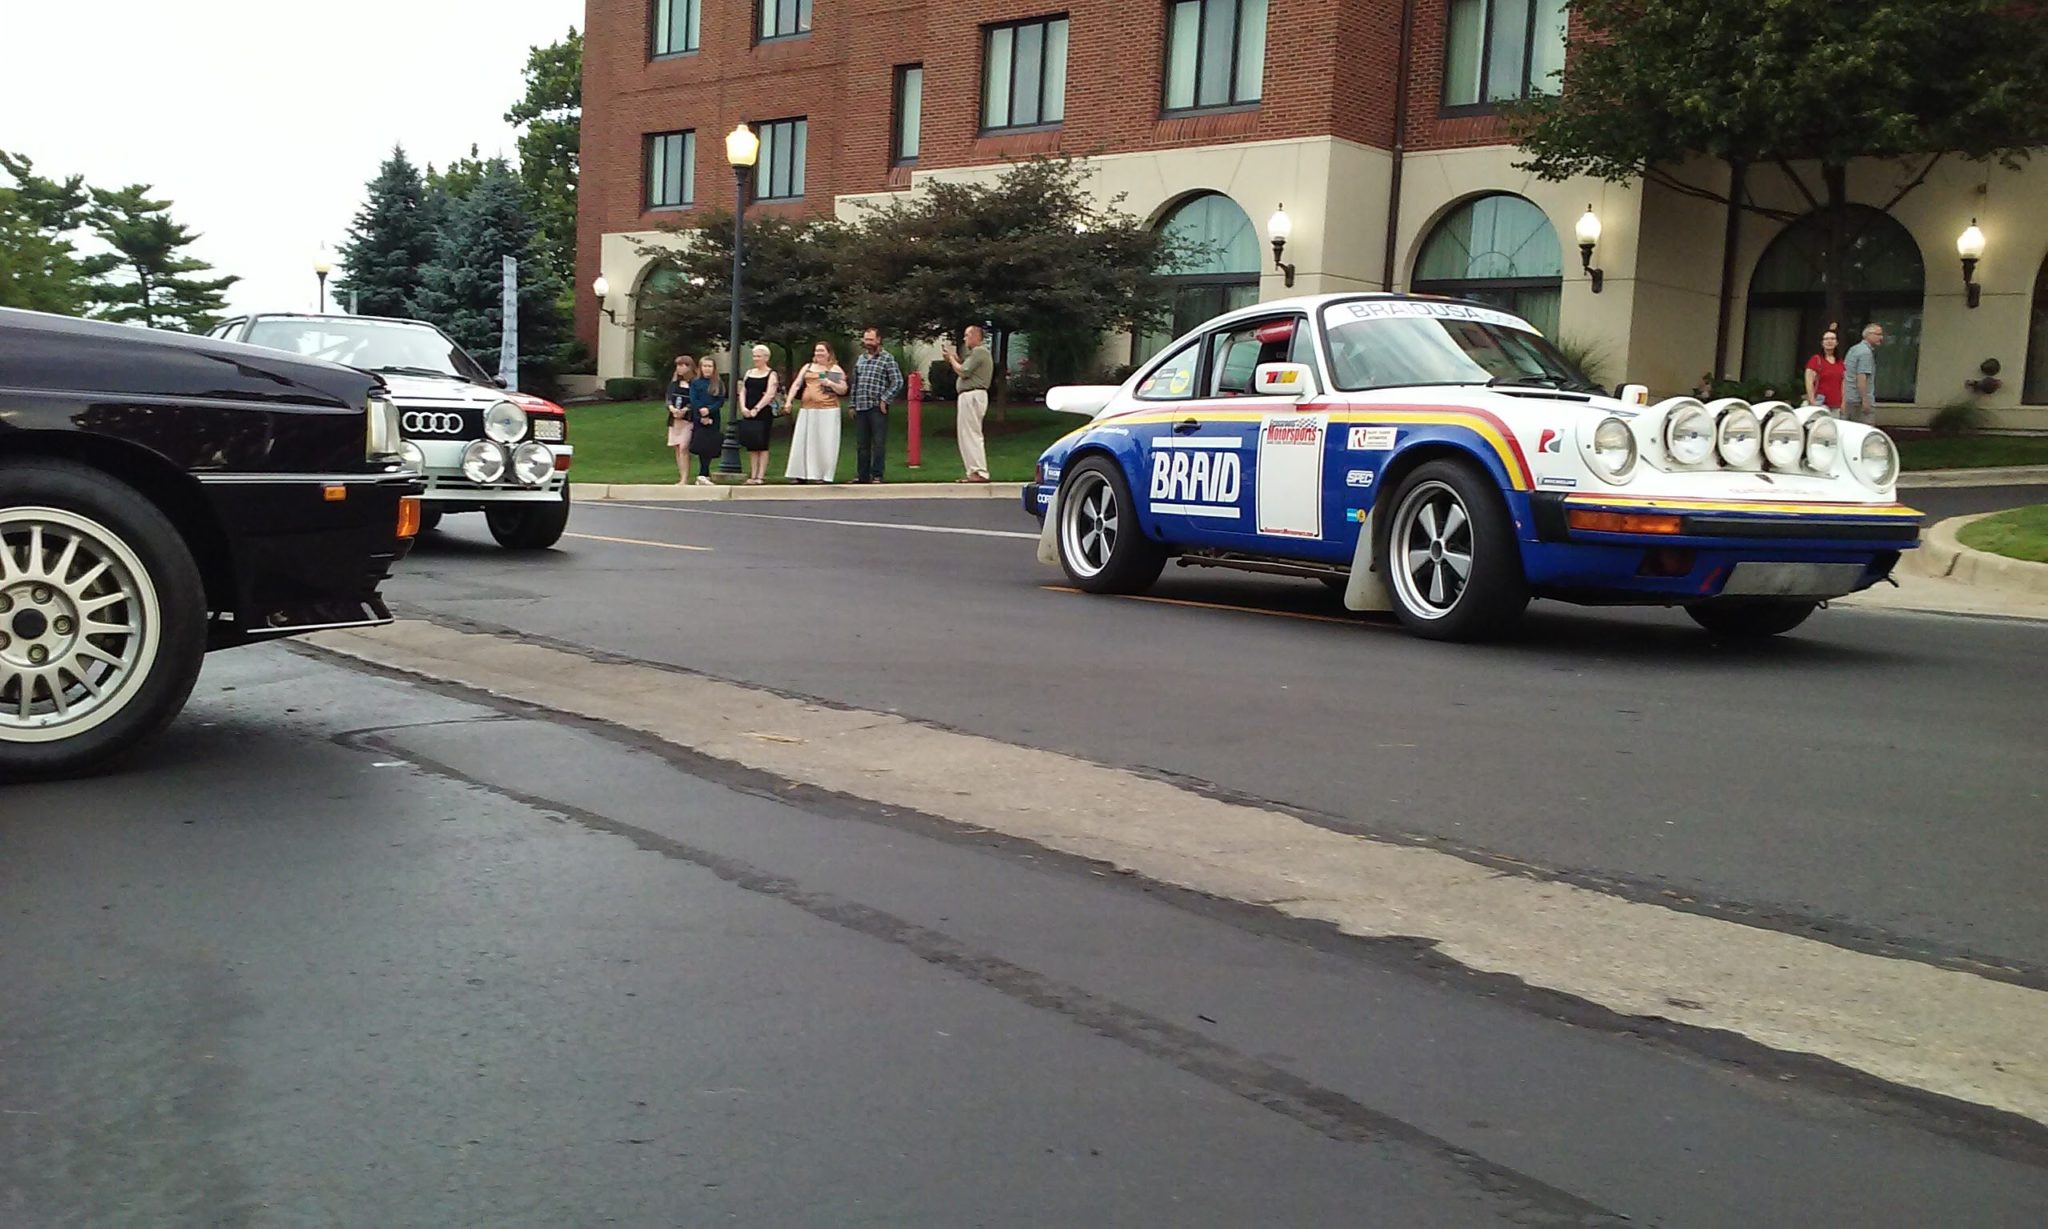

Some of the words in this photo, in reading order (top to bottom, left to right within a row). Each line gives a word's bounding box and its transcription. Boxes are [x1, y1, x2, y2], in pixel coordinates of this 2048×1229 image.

[1266, 423, 1317, 445] Motorsports
[1150, 451, 1240, 503] BRAID
[1348, 473, 1372, 483] SPEC
